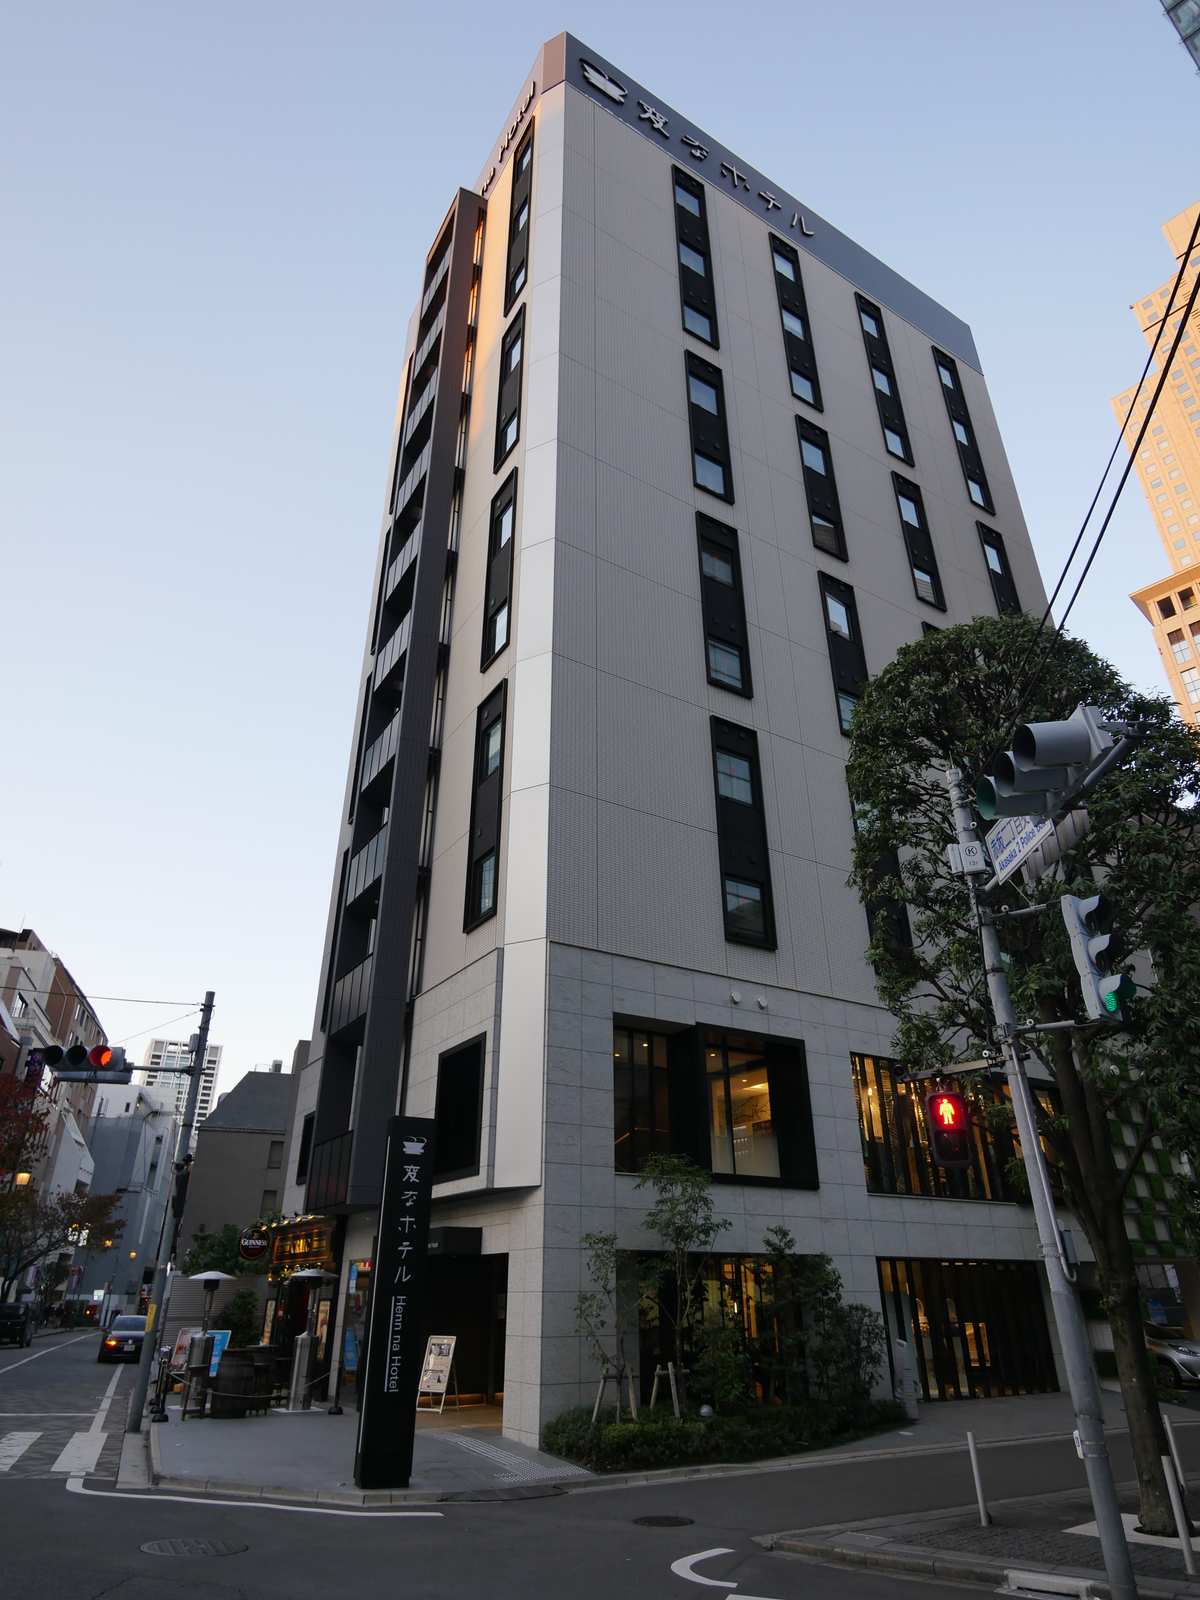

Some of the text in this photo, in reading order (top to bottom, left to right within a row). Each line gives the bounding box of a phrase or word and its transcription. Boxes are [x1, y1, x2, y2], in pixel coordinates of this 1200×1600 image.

[498, 80, 536, 163] Hotel
[637, 100, 815, 236] 変なホテル
[394, 1164, 420, 1284] 変なホテル
[389, 1295, 406, 1393] Henn na Hotel
